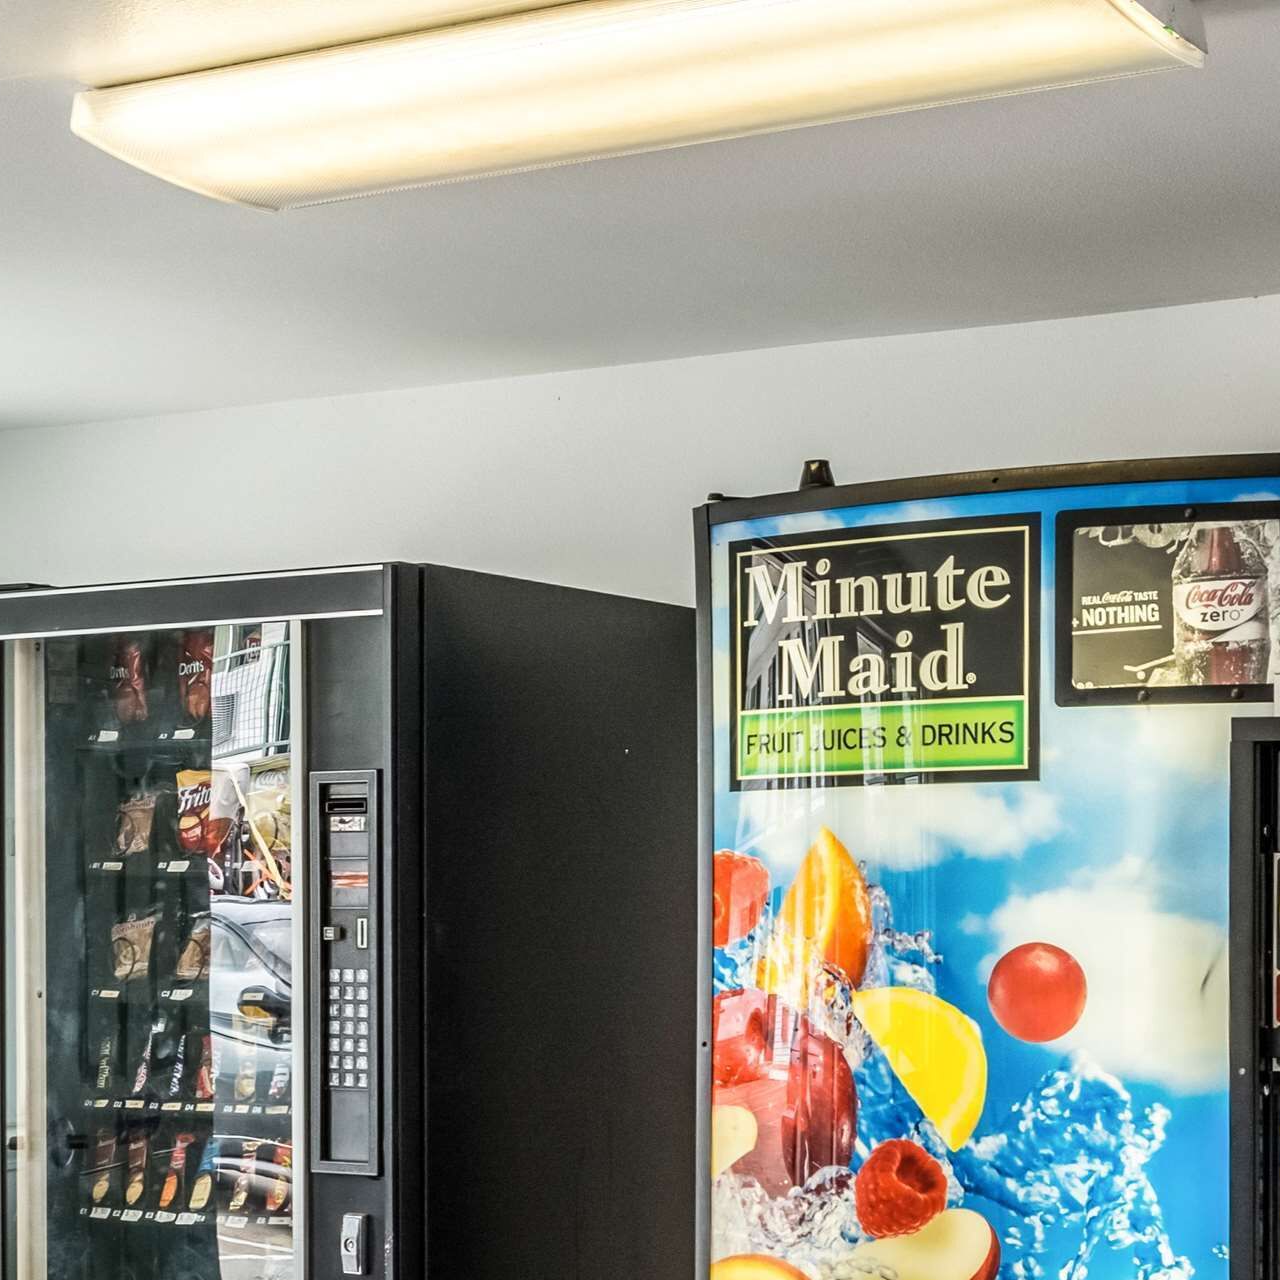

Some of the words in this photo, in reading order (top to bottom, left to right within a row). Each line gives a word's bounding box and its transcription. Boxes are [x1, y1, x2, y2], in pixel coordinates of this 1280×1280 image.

[743, 554, 1011, 628] Minute
[1081, 595, 1102, 606] REAL
[1134, 591, 1159, 601] TASTE
[1185, 581, 1257, 609] Coca-Cola
[1081, 603, 1160, 628] NOTHING
[1200, 608, 1241, 623] zero
[746, 730, 804, 755] FRUIT
[808, 726, 887, 752] JUICES
[895, 725, 912, 748] &
[921, 720, 1016, 747] DRINKS
[184, 1103, 195, 1111] D4
